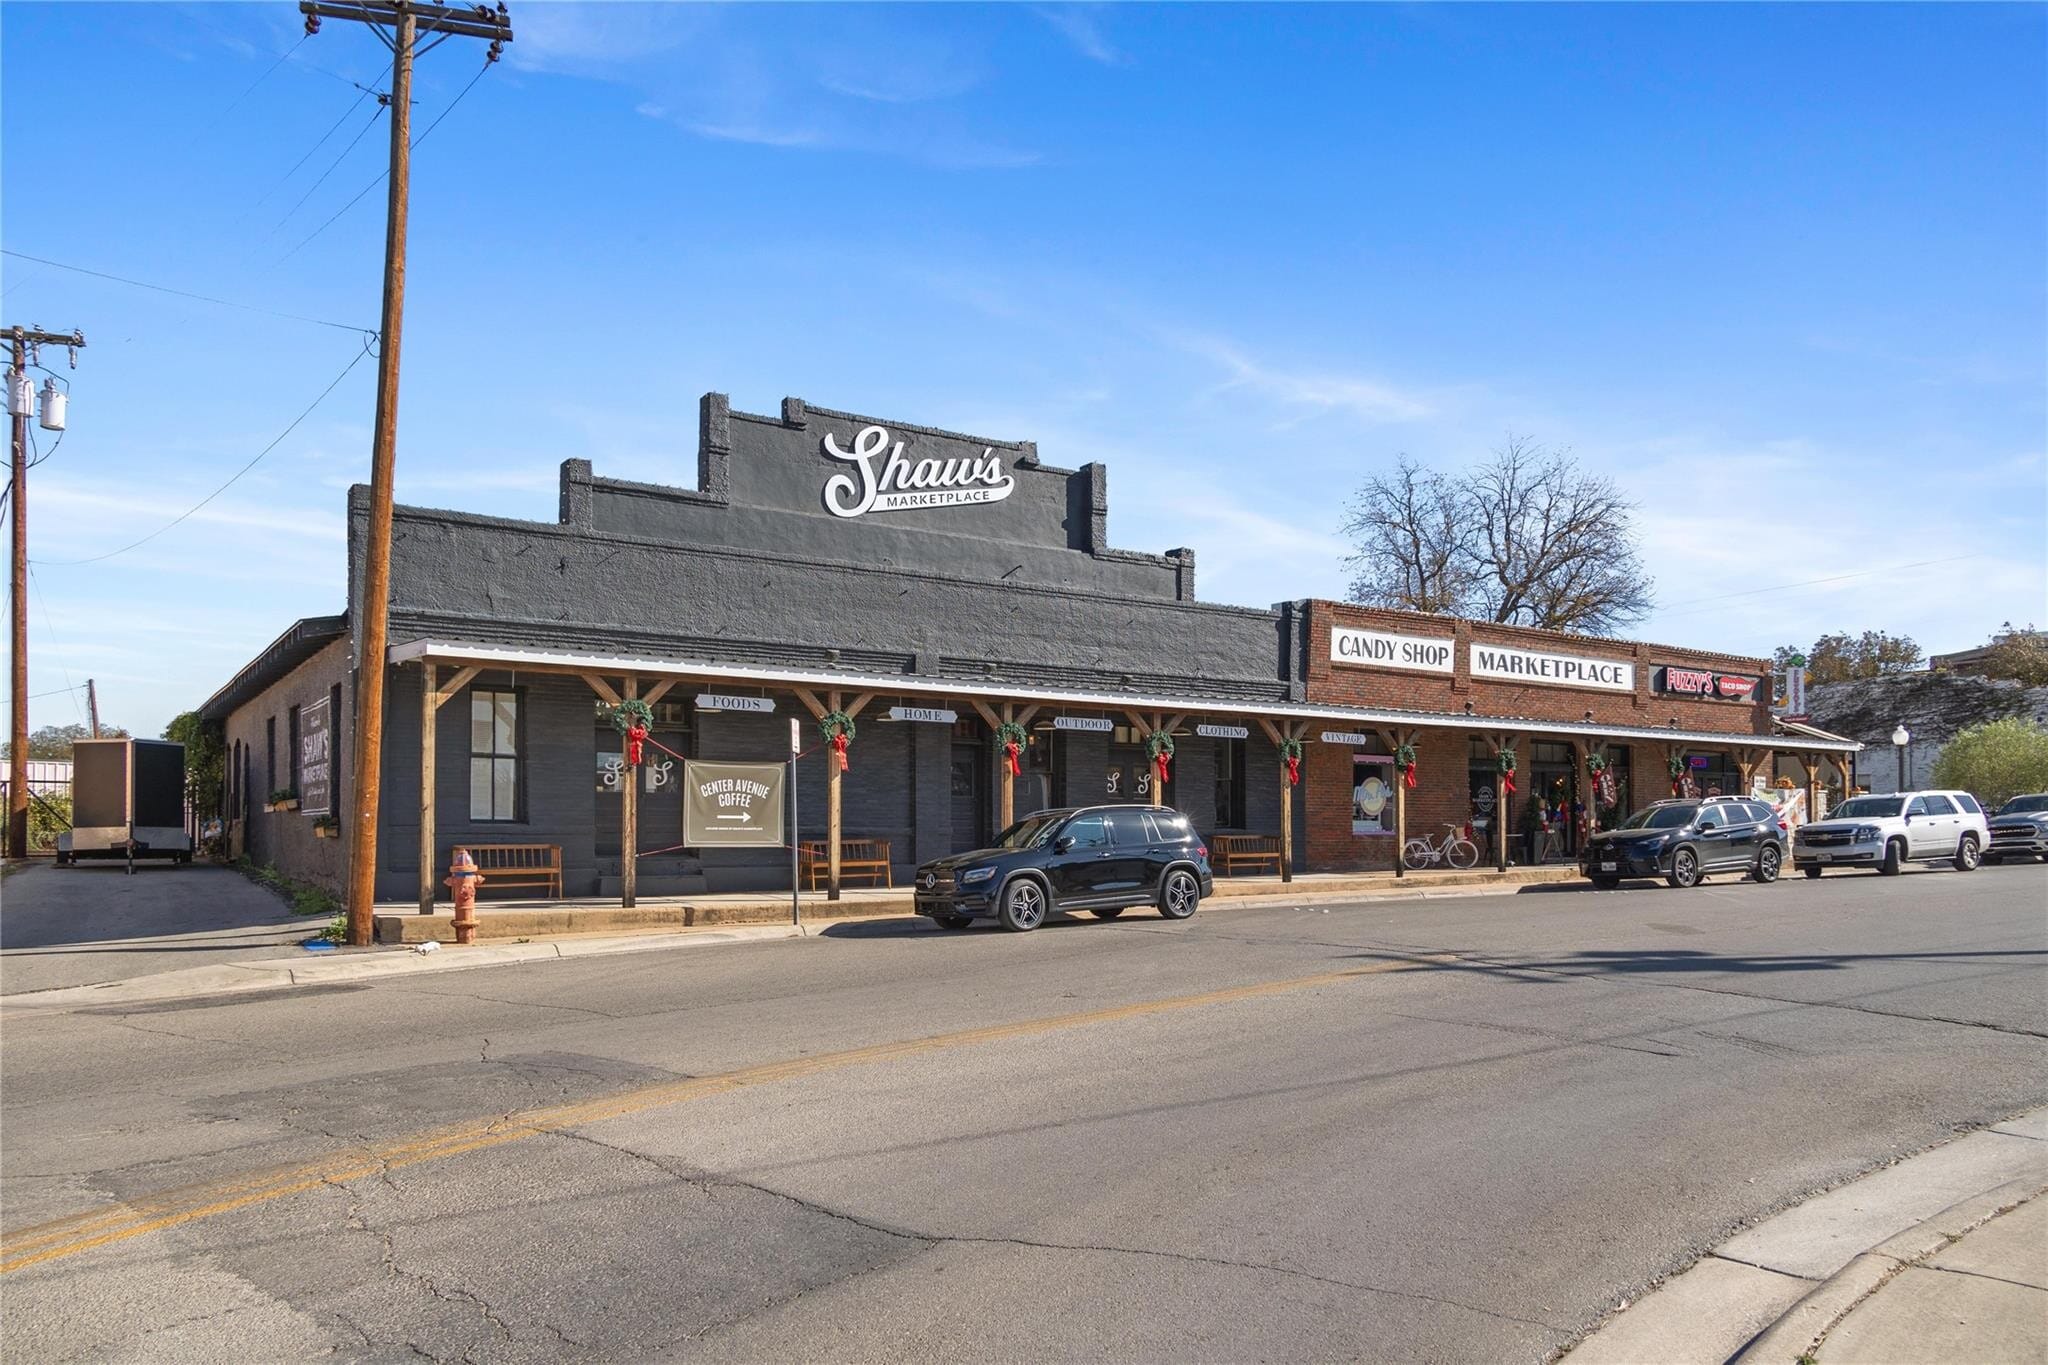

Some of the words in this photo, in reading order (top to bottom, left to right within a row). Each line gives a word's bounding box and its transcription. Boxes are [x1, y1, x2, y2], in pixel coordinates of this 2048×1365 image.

[824, 425, 1014, 517] Shaw's
[886, 490, 990, 507] MARKETPLACE
[1338, 635, 1398, 660] CANDY
[1402, 642, 1450, 666] SHOP
[1477, 651, 1624, 684] MARKETPLACE
[1667, 667, 1713, 693] FUZZY'S
[1721, 681, 1736, 690] TACO
[1736, 682, 1752, 691] SHOP
[712, 696, 761, 709] FOODS
[904, 709, 942, 721] HOME
[1056, 718, 1111, 730] OUTDOOR
[1199, 725, 1246, 737] CLOTHING
[700, 778, 734, 798] CENTER
[735, 778, 771, 800] AVENUE
[718, 792, 753, 808] COFFEE
